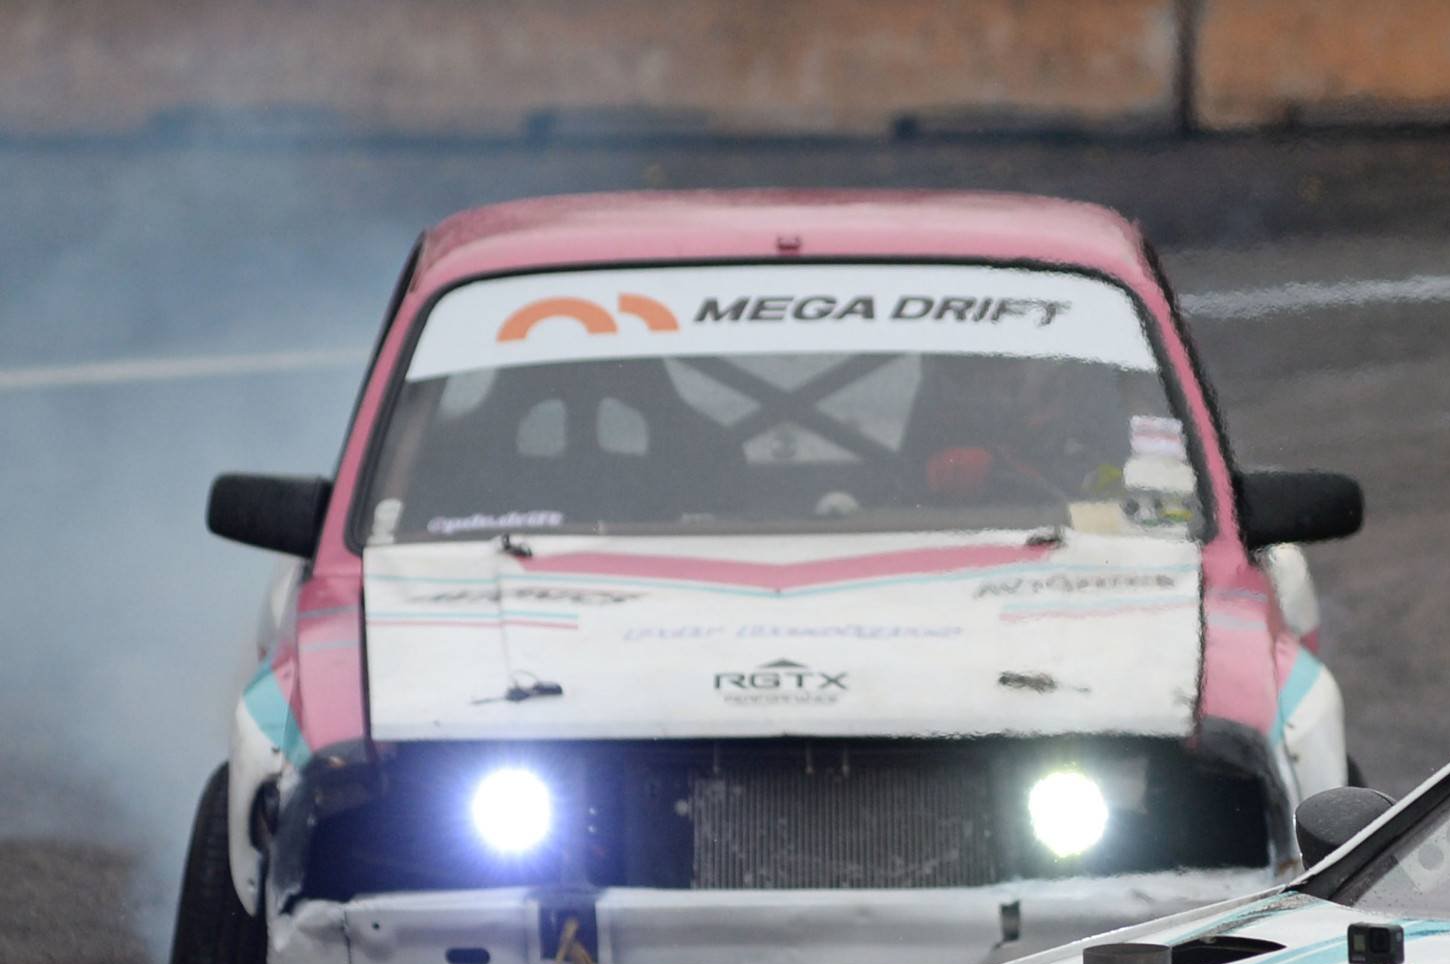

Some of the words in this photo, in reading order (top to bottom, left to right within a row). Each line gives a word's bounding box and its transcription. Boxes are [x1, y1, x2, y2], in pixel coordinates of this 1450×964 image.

[694, 296, 876, 322] MEGA
[889, 296, 1072, 327] DRIFT
[713, 671, 848, 690] RGTX
